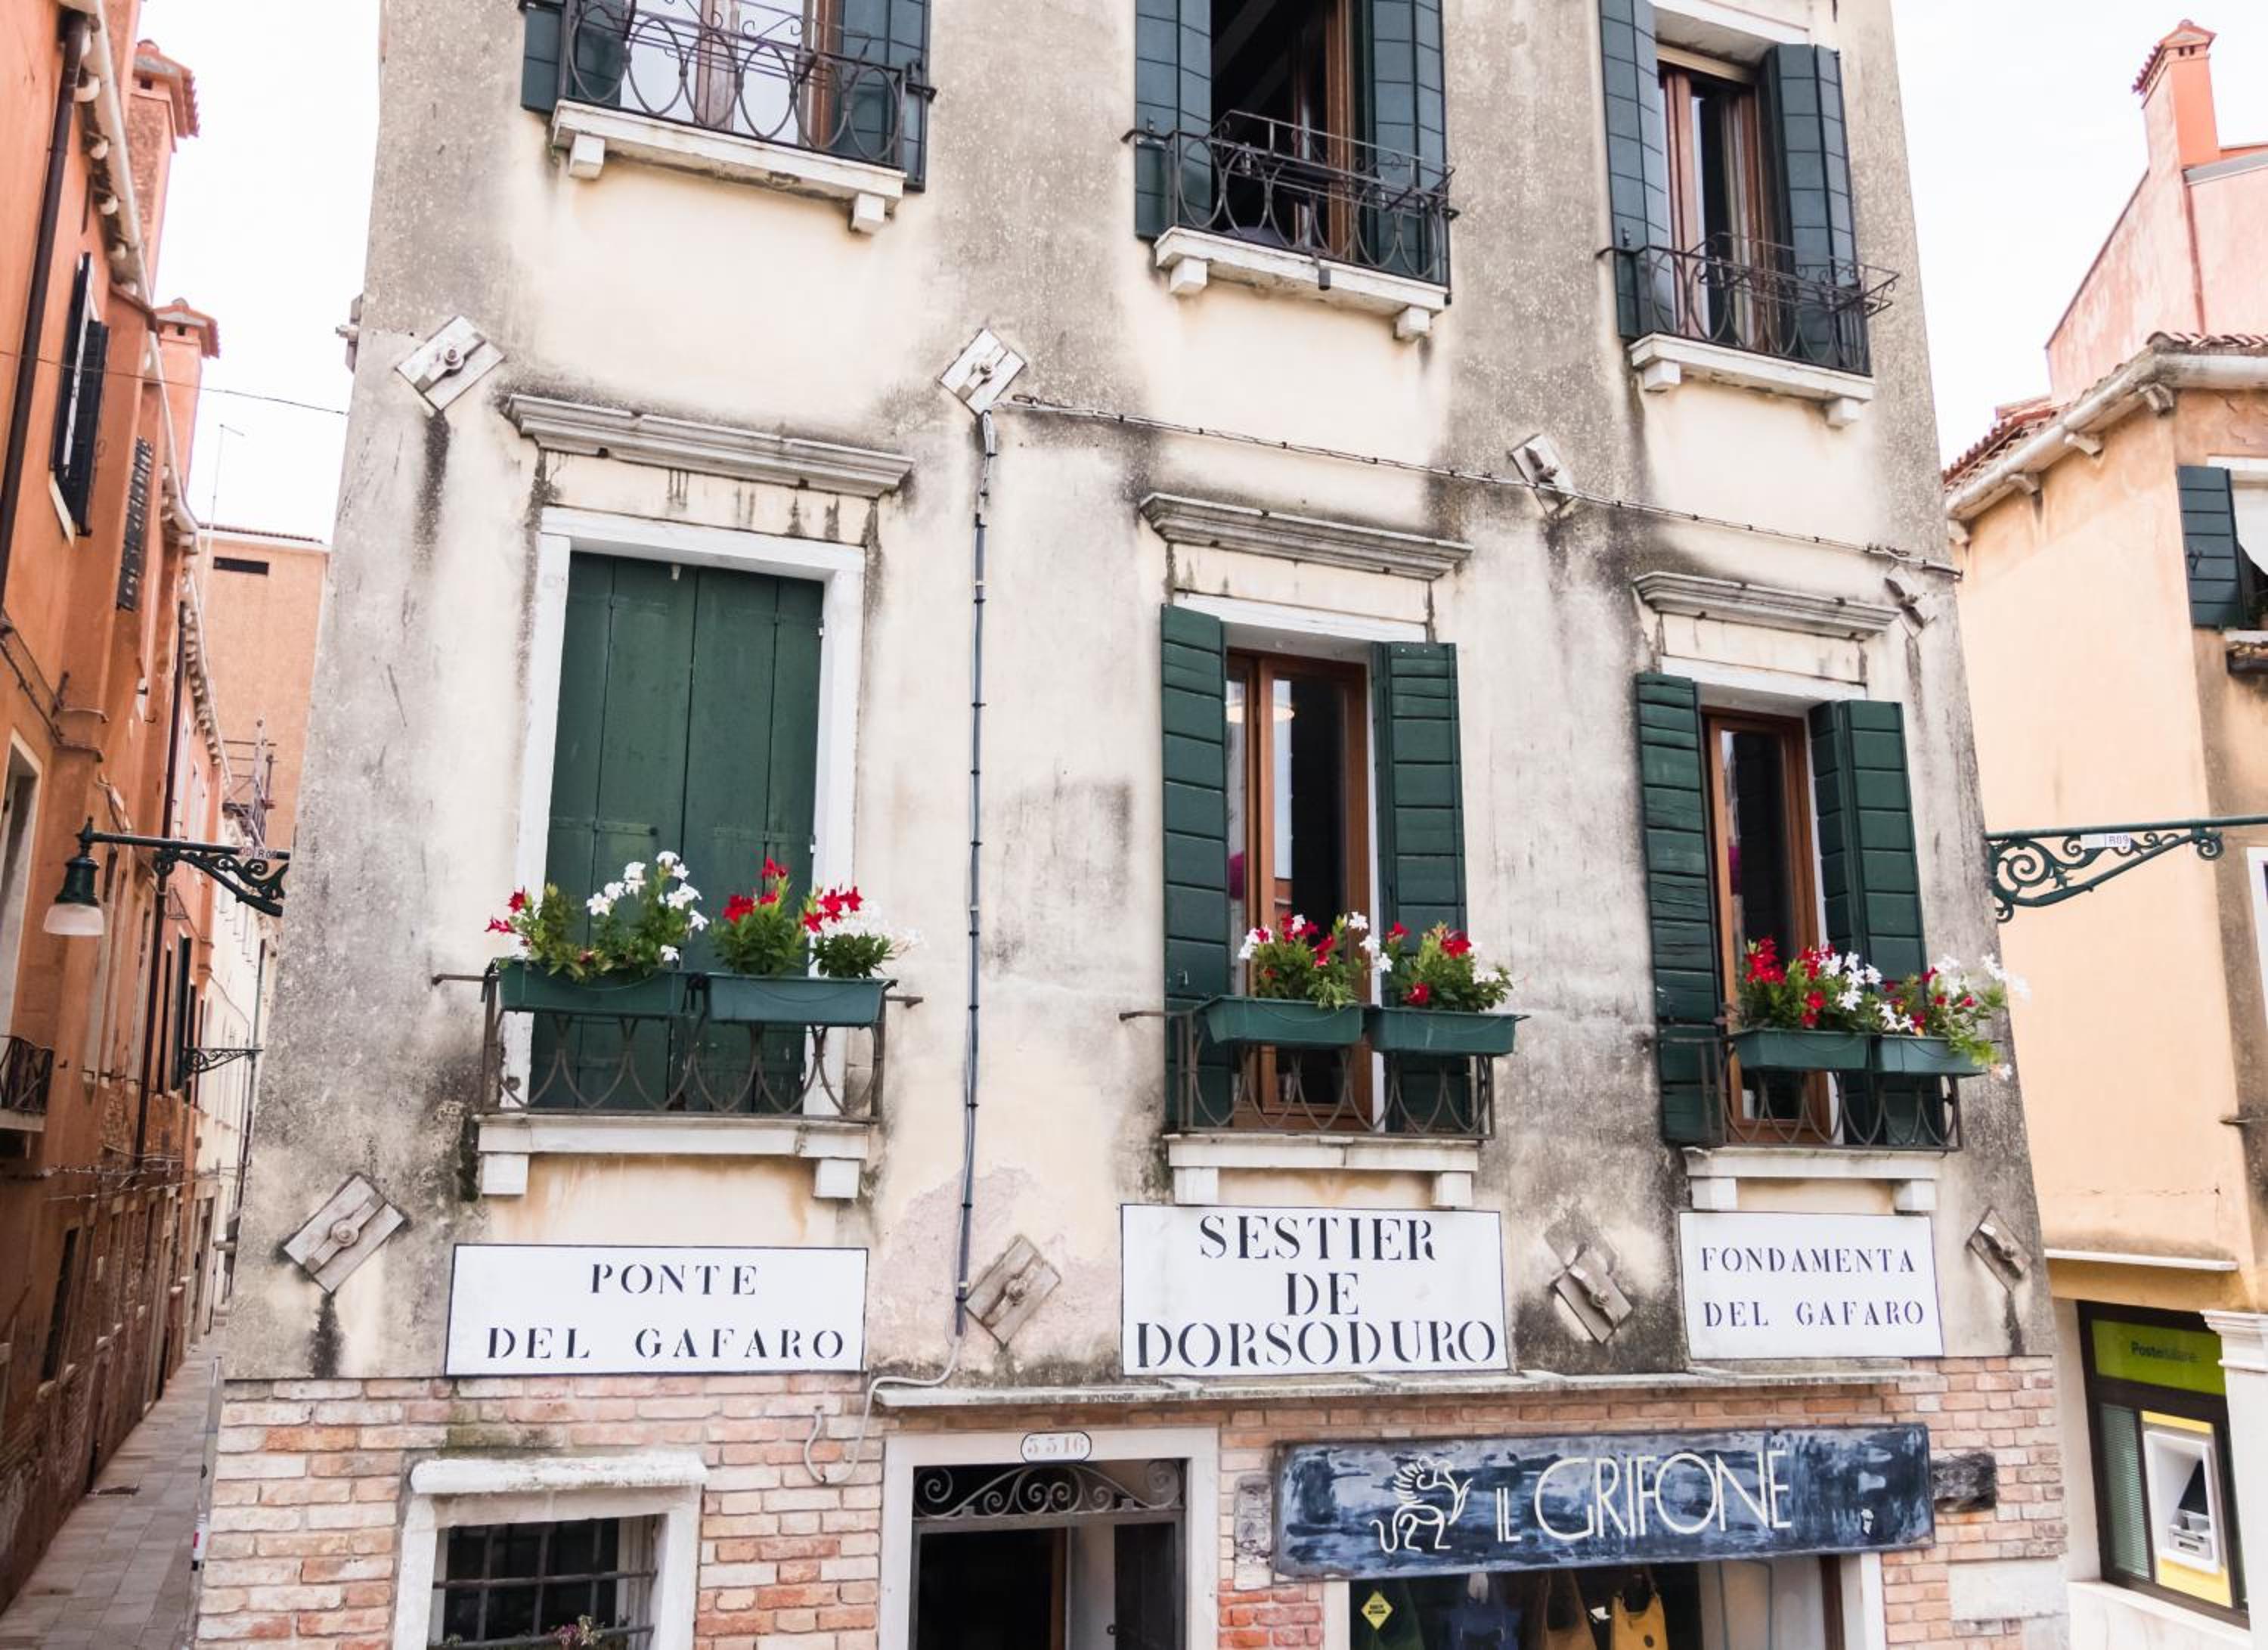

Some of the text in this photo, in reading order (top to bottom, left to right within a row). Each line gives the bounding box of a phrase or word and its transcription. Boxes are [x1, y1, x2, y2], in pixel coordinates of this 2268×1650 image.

[1200, 1215, 1436, 1261] SESTIER
[1702, 1247, 1915, 1273] FONDAMENTA
[591, 1264, 757, 1295] PONTE
[1286, 1272, 1359, 1316] DE
[1703, 1301, 1924, 1327] DEL GAFARO
[488, 1327, 844, 1359] DEL GAFARO
[1137, 1320, 1496, 1369] DORSODURO
[1496, 1450, 1792, 1542] IL GRIFONE
